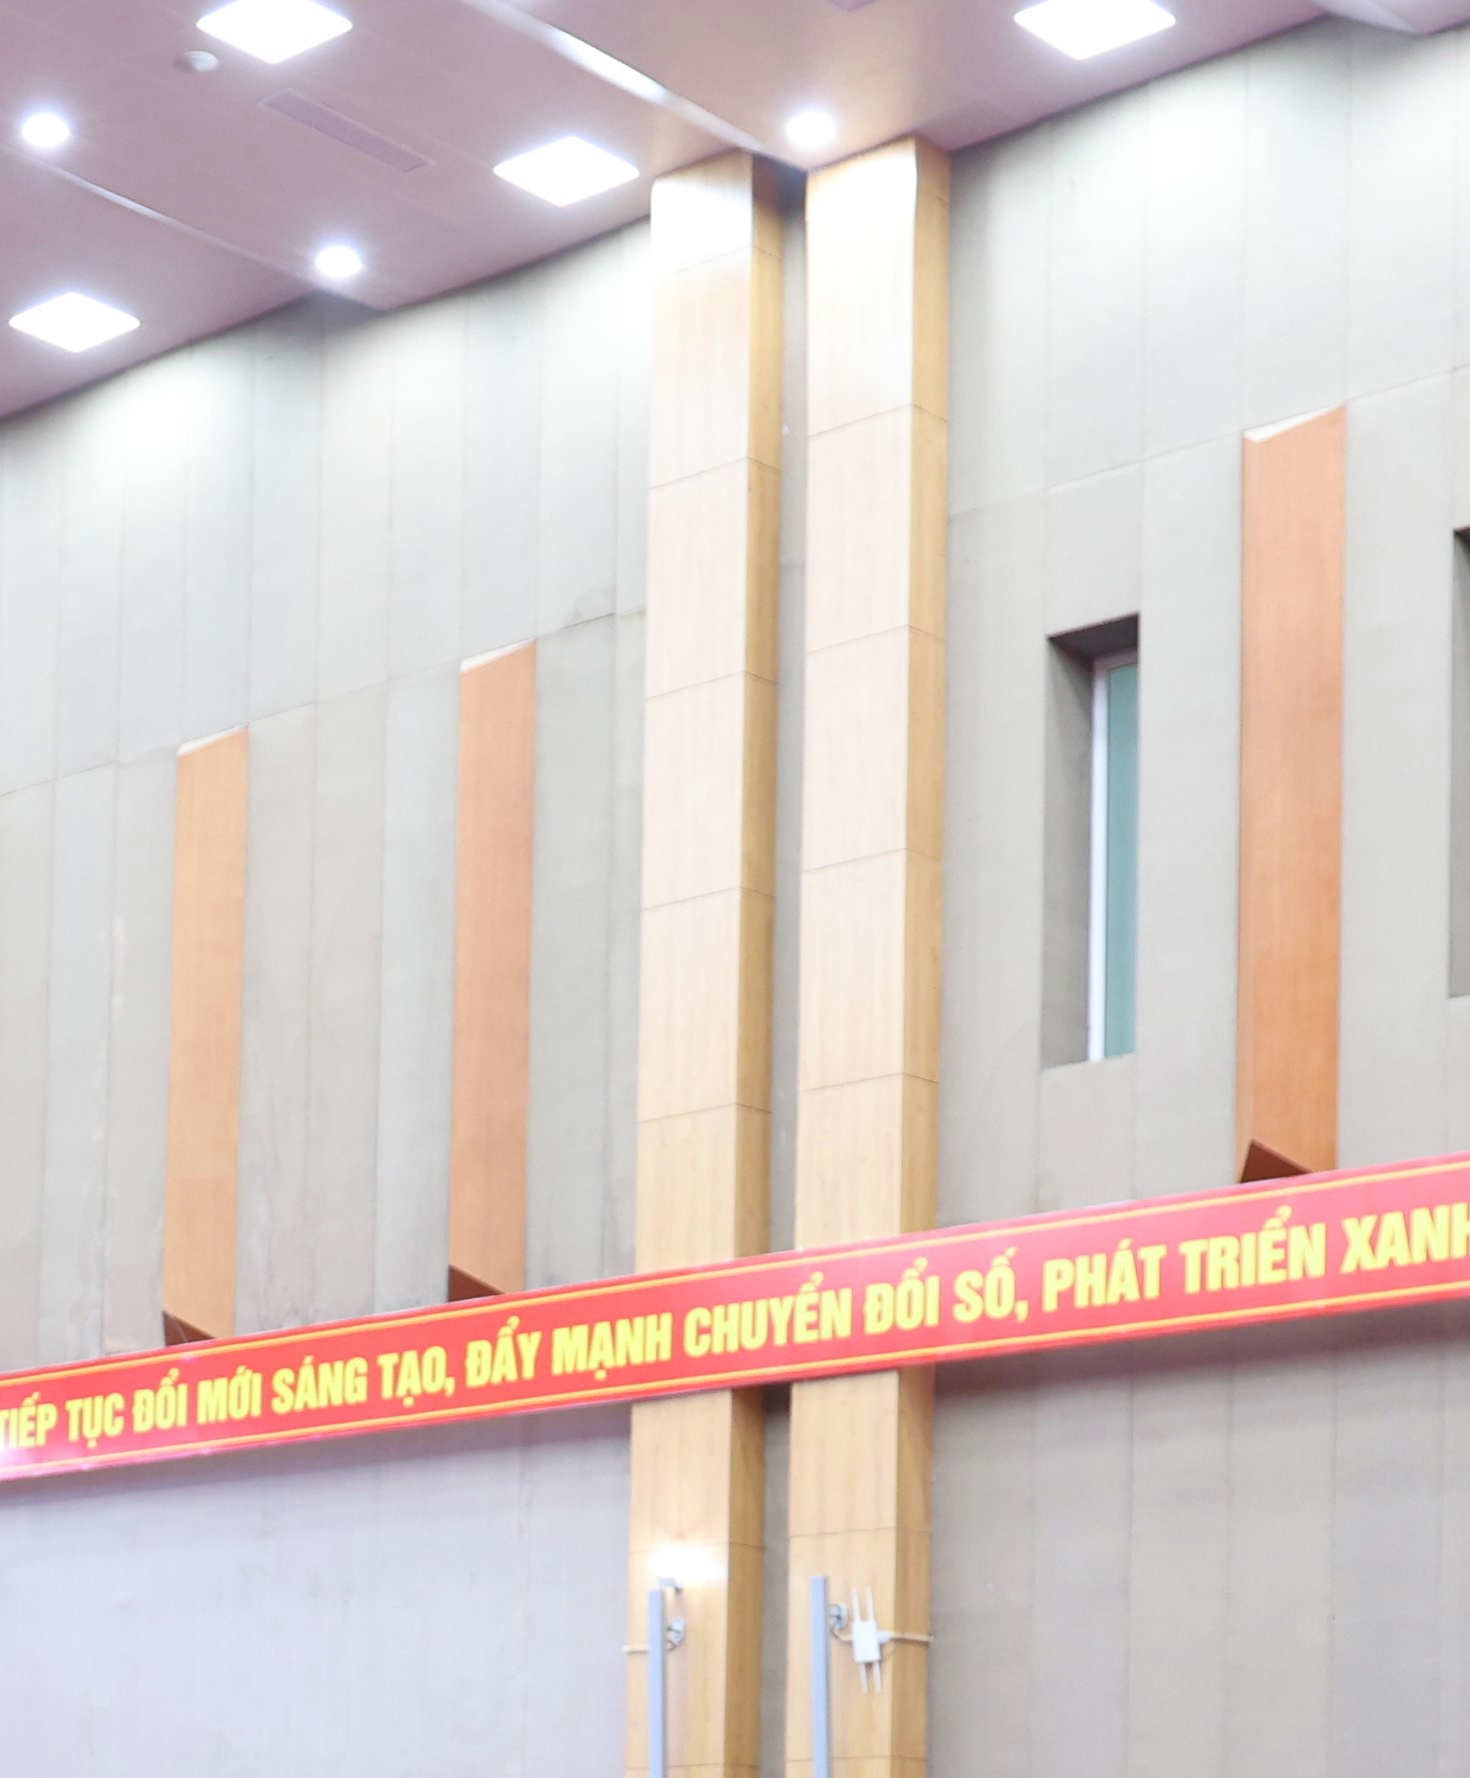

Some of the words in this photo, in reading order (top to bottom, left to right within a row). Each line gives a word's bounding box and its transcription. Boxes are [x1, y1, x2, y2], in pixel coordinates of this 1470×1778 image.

[65, 1392, 125, 1448] TỤC
[132, 1368, 188, 1433] ĐỔI
[196, 1364, 262, 1425] MỚI
[271, 1356, 368, 1415] SÁNG
[377, 1345, 455, 1407] TẠO,
[465, 1315, 542, 1389] ĐẨY
[552, 1312, 673, 1381] MẠNH
[683, 1271, 852, 1358] CHUYỂN
[864, 1256, 939, 1335] ĐỔI
[953, 1246, 1028, 1324] SỐ,
[1043, 1238, 1167, 1312] PHÁT
[1178, 1205, 1326, 1294] TRIỂN
